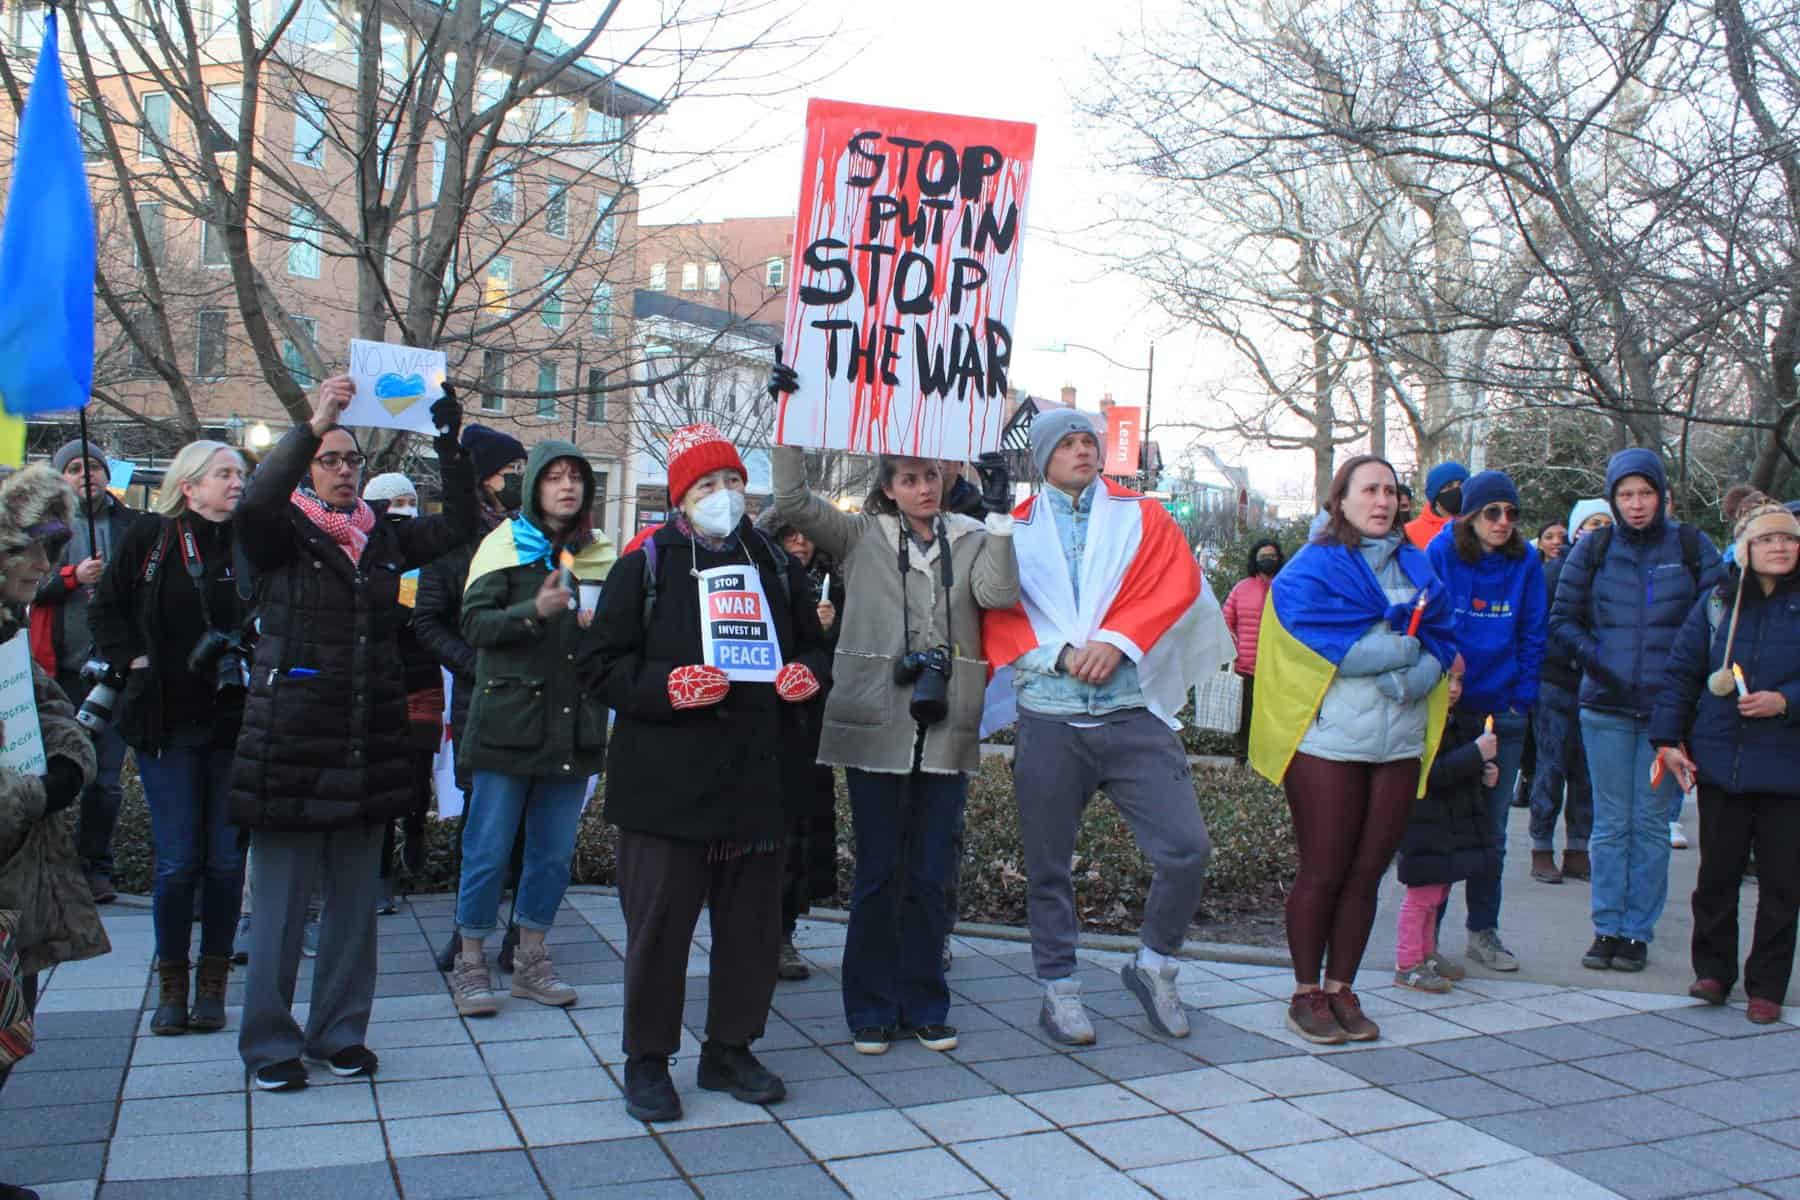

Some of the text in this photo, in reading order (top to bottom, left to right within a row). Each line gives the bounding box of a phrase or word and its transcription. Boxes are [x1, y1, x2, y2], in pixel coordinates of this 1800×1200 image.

[845, 131, 1004, 200] STOP
[869, 195, 1017, 254] PUTIN
[800, 238, 987, 315] STOP
[352, 343, 383, 376] NO
[811, 318, 1012, 402] THE WAR
[714, 577, 739, 589] STOP
[715, 597, 756, 615] WAR
[718, 625, 761, 636] INVEST IN
[720, 646, 770, 665] PEACE
